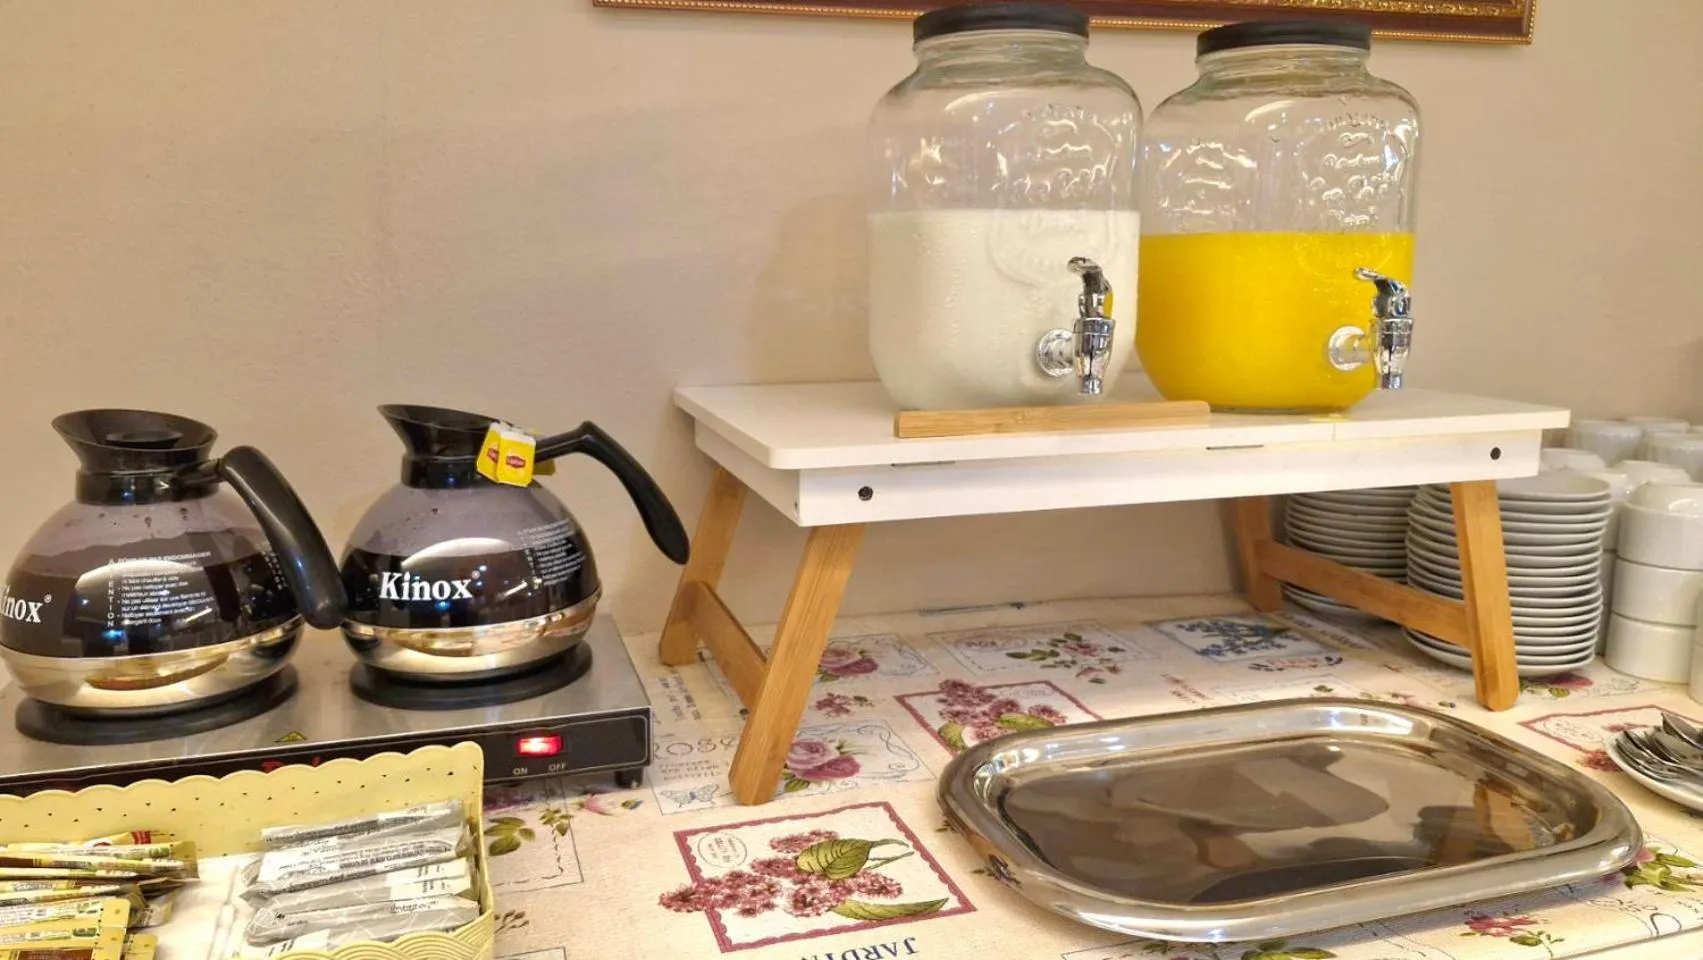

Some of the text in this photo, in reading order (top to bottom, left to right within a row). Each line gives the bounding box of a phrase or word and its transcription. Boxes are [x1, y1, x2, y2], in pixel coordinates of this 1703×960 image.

[378, 571, 473, 600] Kinox
[0, 584, 44, 623] inox
[512, 767, 528, 776] ON
[548, 762, 567, 772] OFF
[800, 936, 919, 960] JARD
